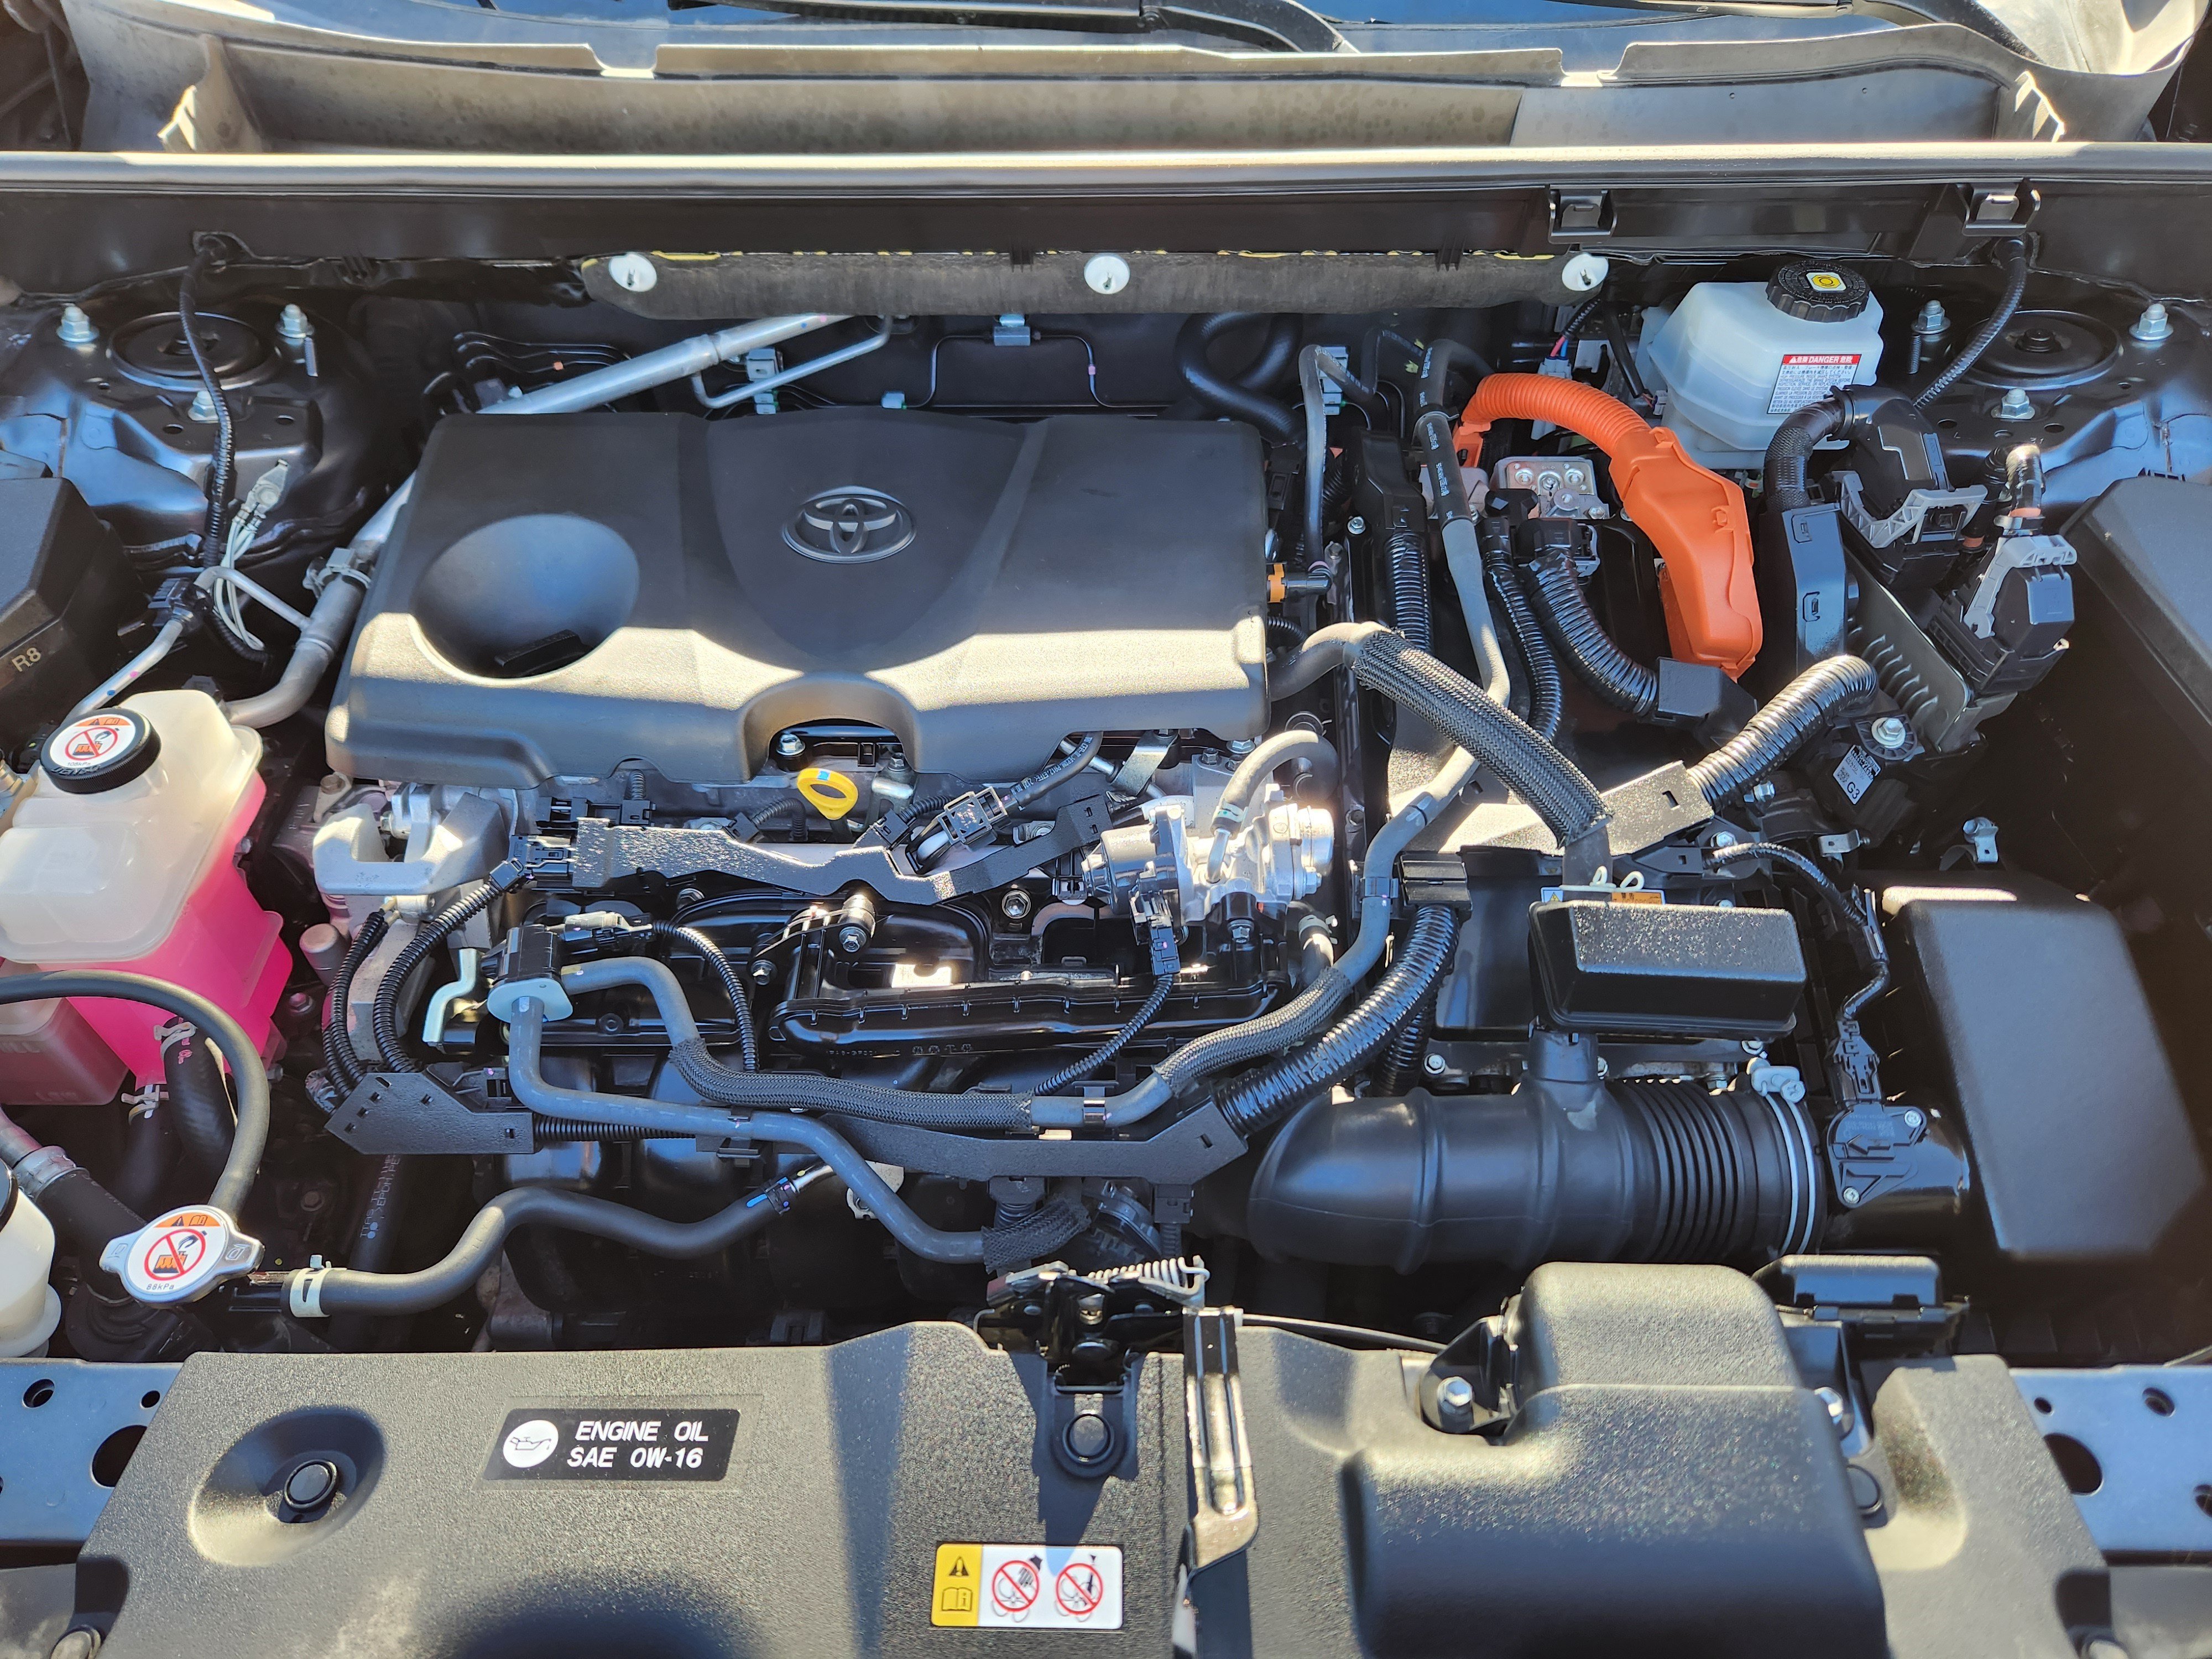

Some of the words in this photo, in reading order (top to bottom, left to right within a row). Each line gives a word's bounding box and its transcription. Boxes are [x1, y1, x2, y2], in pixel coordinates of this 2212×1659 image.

[12, 648, 41, 672] R8
[1847, 781, 1860, 799] G3
[575, 1421, 661, 1441] ENGINE
[674, 1421, 708, 1441] OIL
[567, 1447, 618, 1468] SAE
